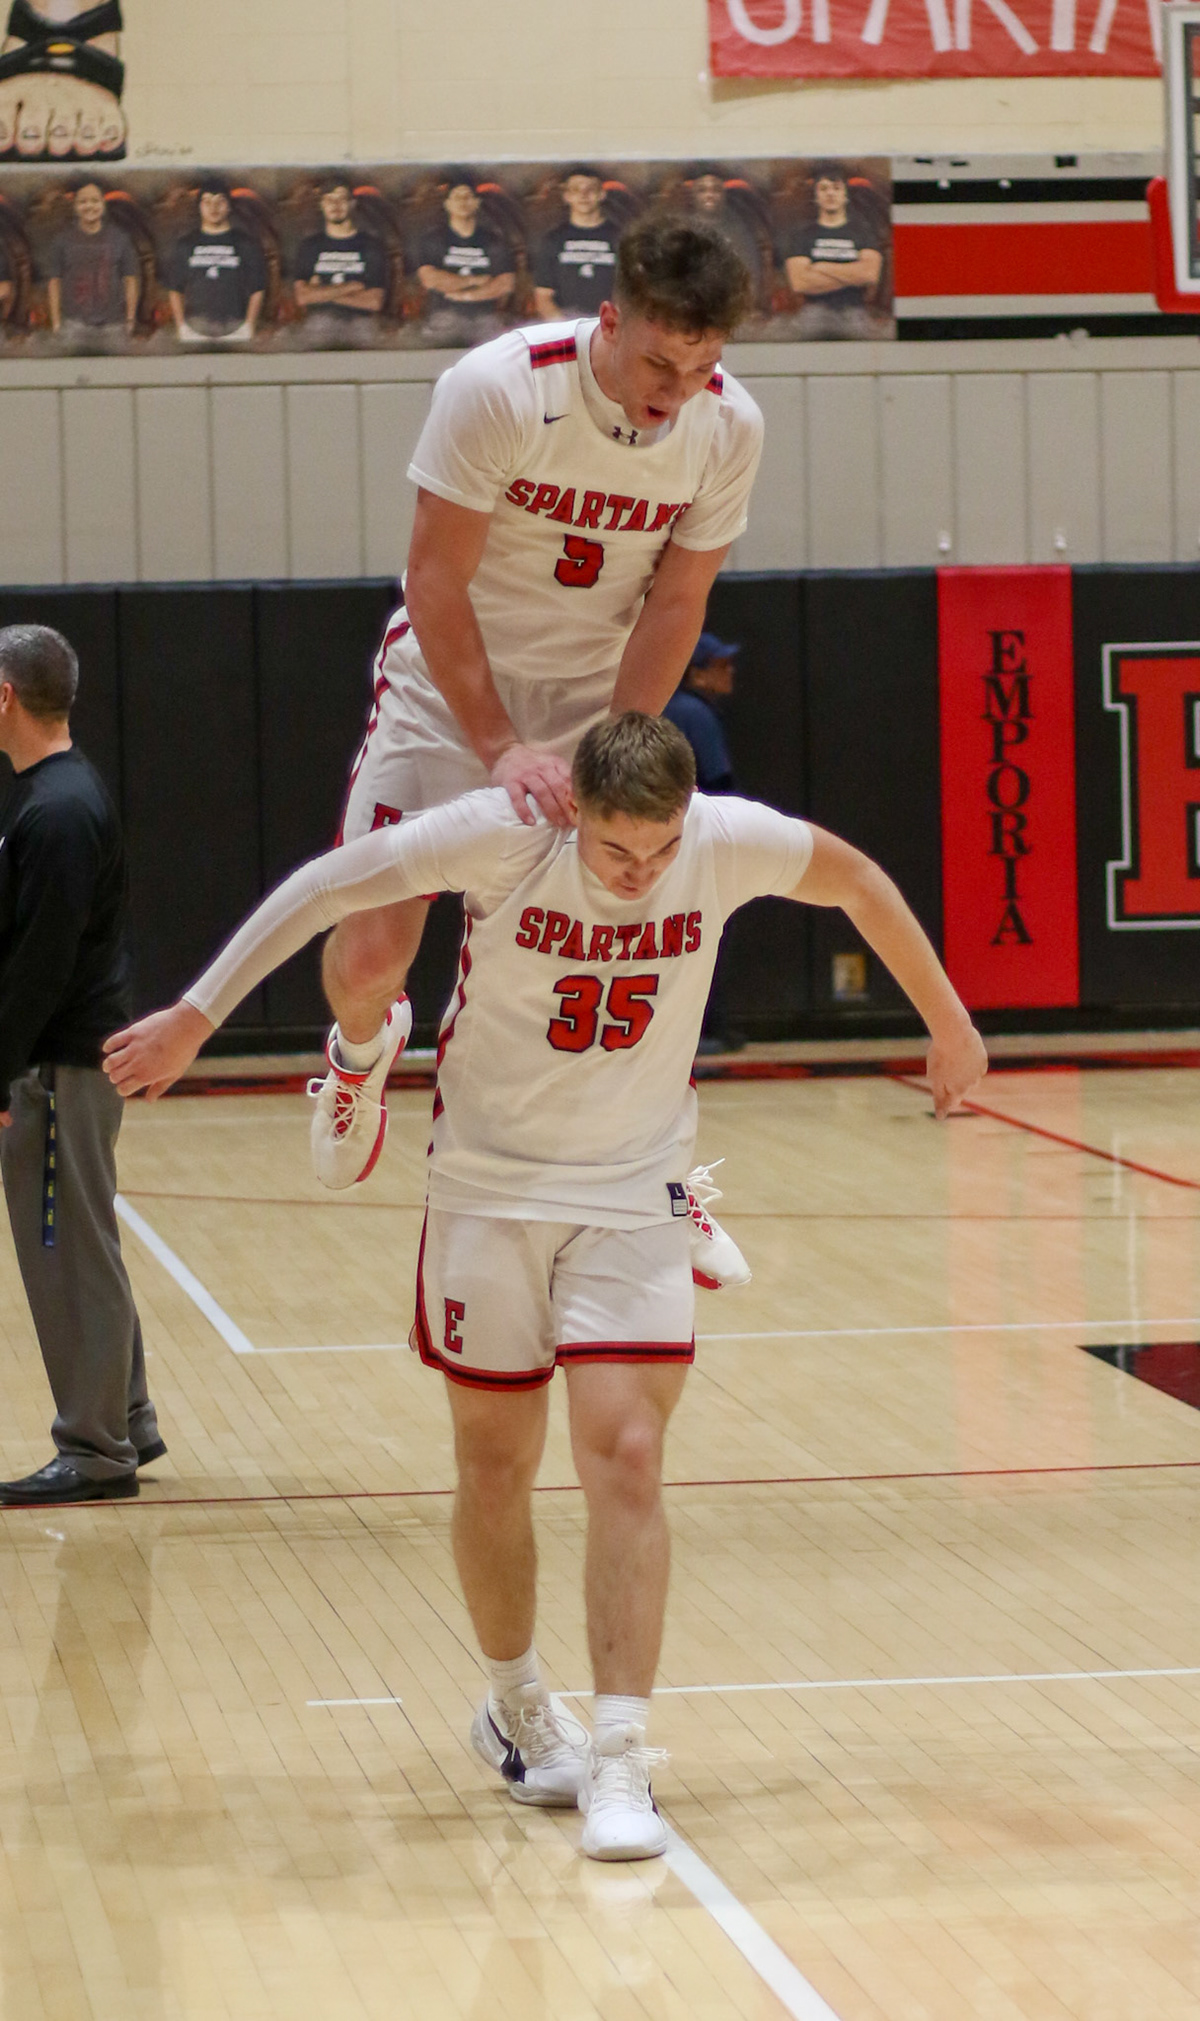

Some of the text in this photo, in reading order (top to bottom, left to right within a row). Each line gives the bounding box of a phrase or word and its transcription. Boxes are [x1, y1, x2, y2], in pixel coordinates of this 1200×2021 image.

[554, 533, 604, 588] 5
[981, 630, 1034, 945] EMPORIA
[515, 906, 702, 962] SPARTANS
[546, 974, 660, 1053] 35
[444, 1297, 466, 1355] E
